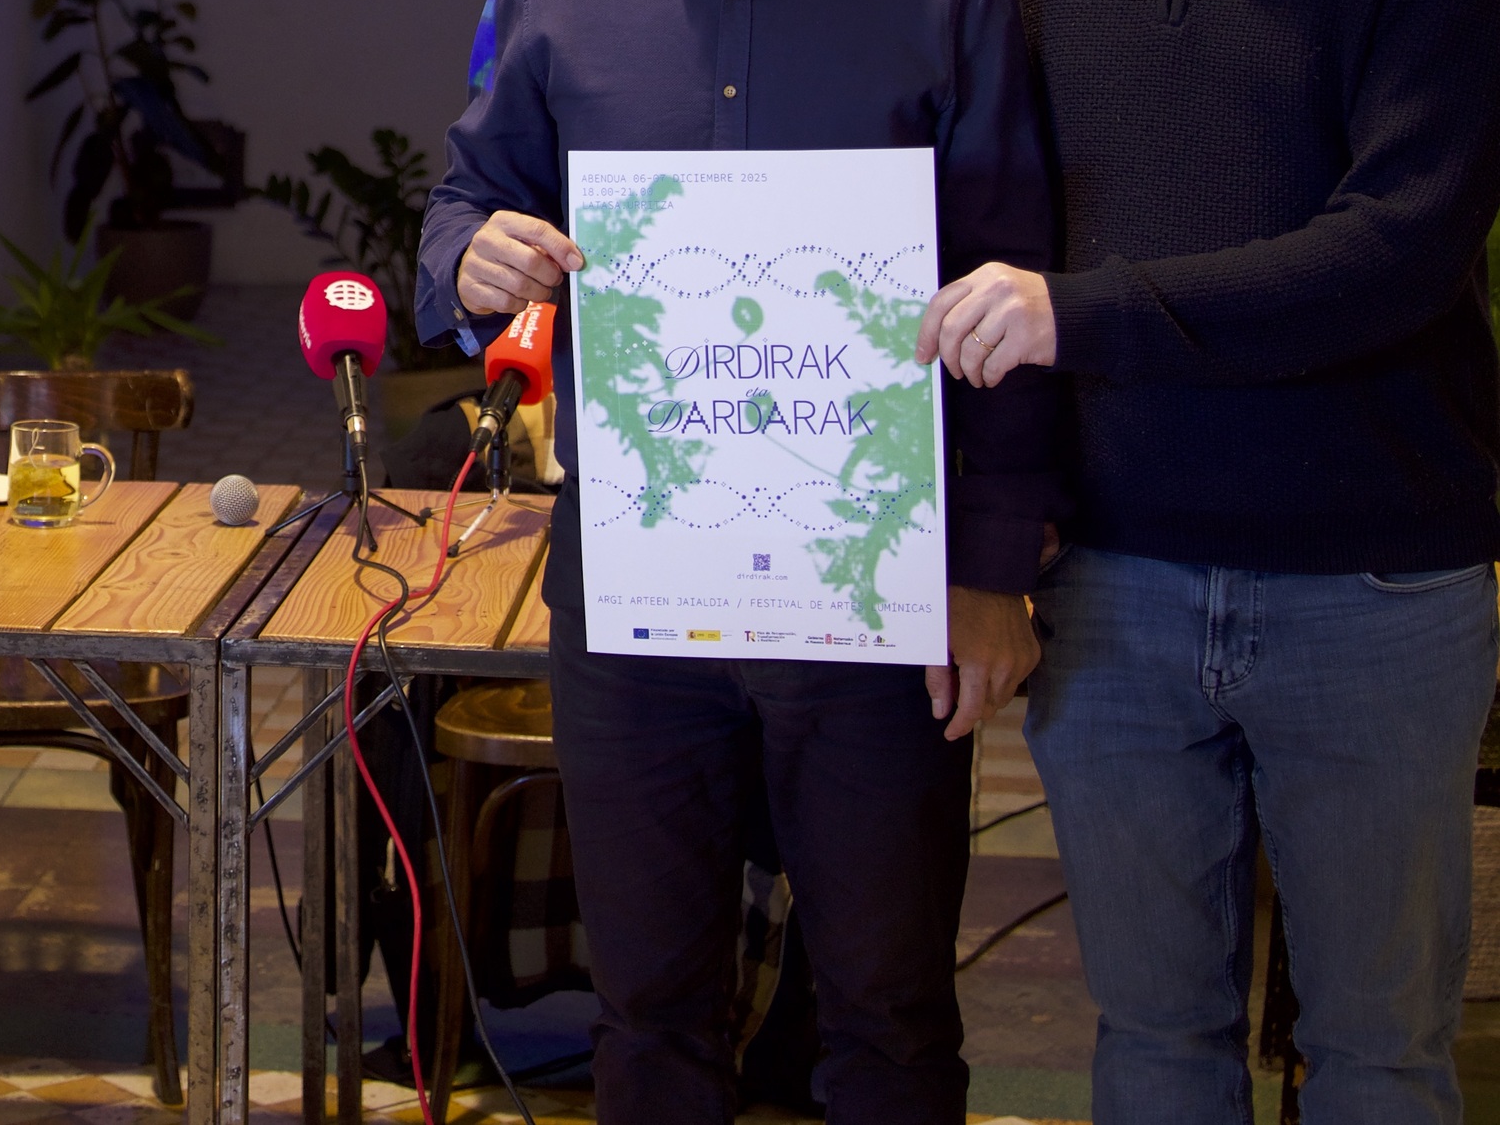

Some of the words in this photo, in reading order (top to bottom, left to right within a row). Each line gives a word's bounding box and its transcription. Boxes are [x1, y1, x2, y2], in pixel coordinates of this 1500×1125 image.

[581, 174, 627, 183] ABENDUA
[672, 173, 734, 183] DICIEMBRE
[740, 173, 768, 183] 2025
[663, 343, 852, 380] DIRDIRAK
[745, 386, 770, 398] eta
[647, 399, 874, 437] DARDARAK
[736, 572, 788, 581] dirdirak.com
[597, 595, 623, 606] ARGI
[629, 596, 670, 607] ARTEEN
[676, 596, 730, 608] JAIALDIA
[749, 598, 803, 610] FESTIVAL
[810, 599, 823, 611] DE
[830, 600, 864, 612] ARTES
